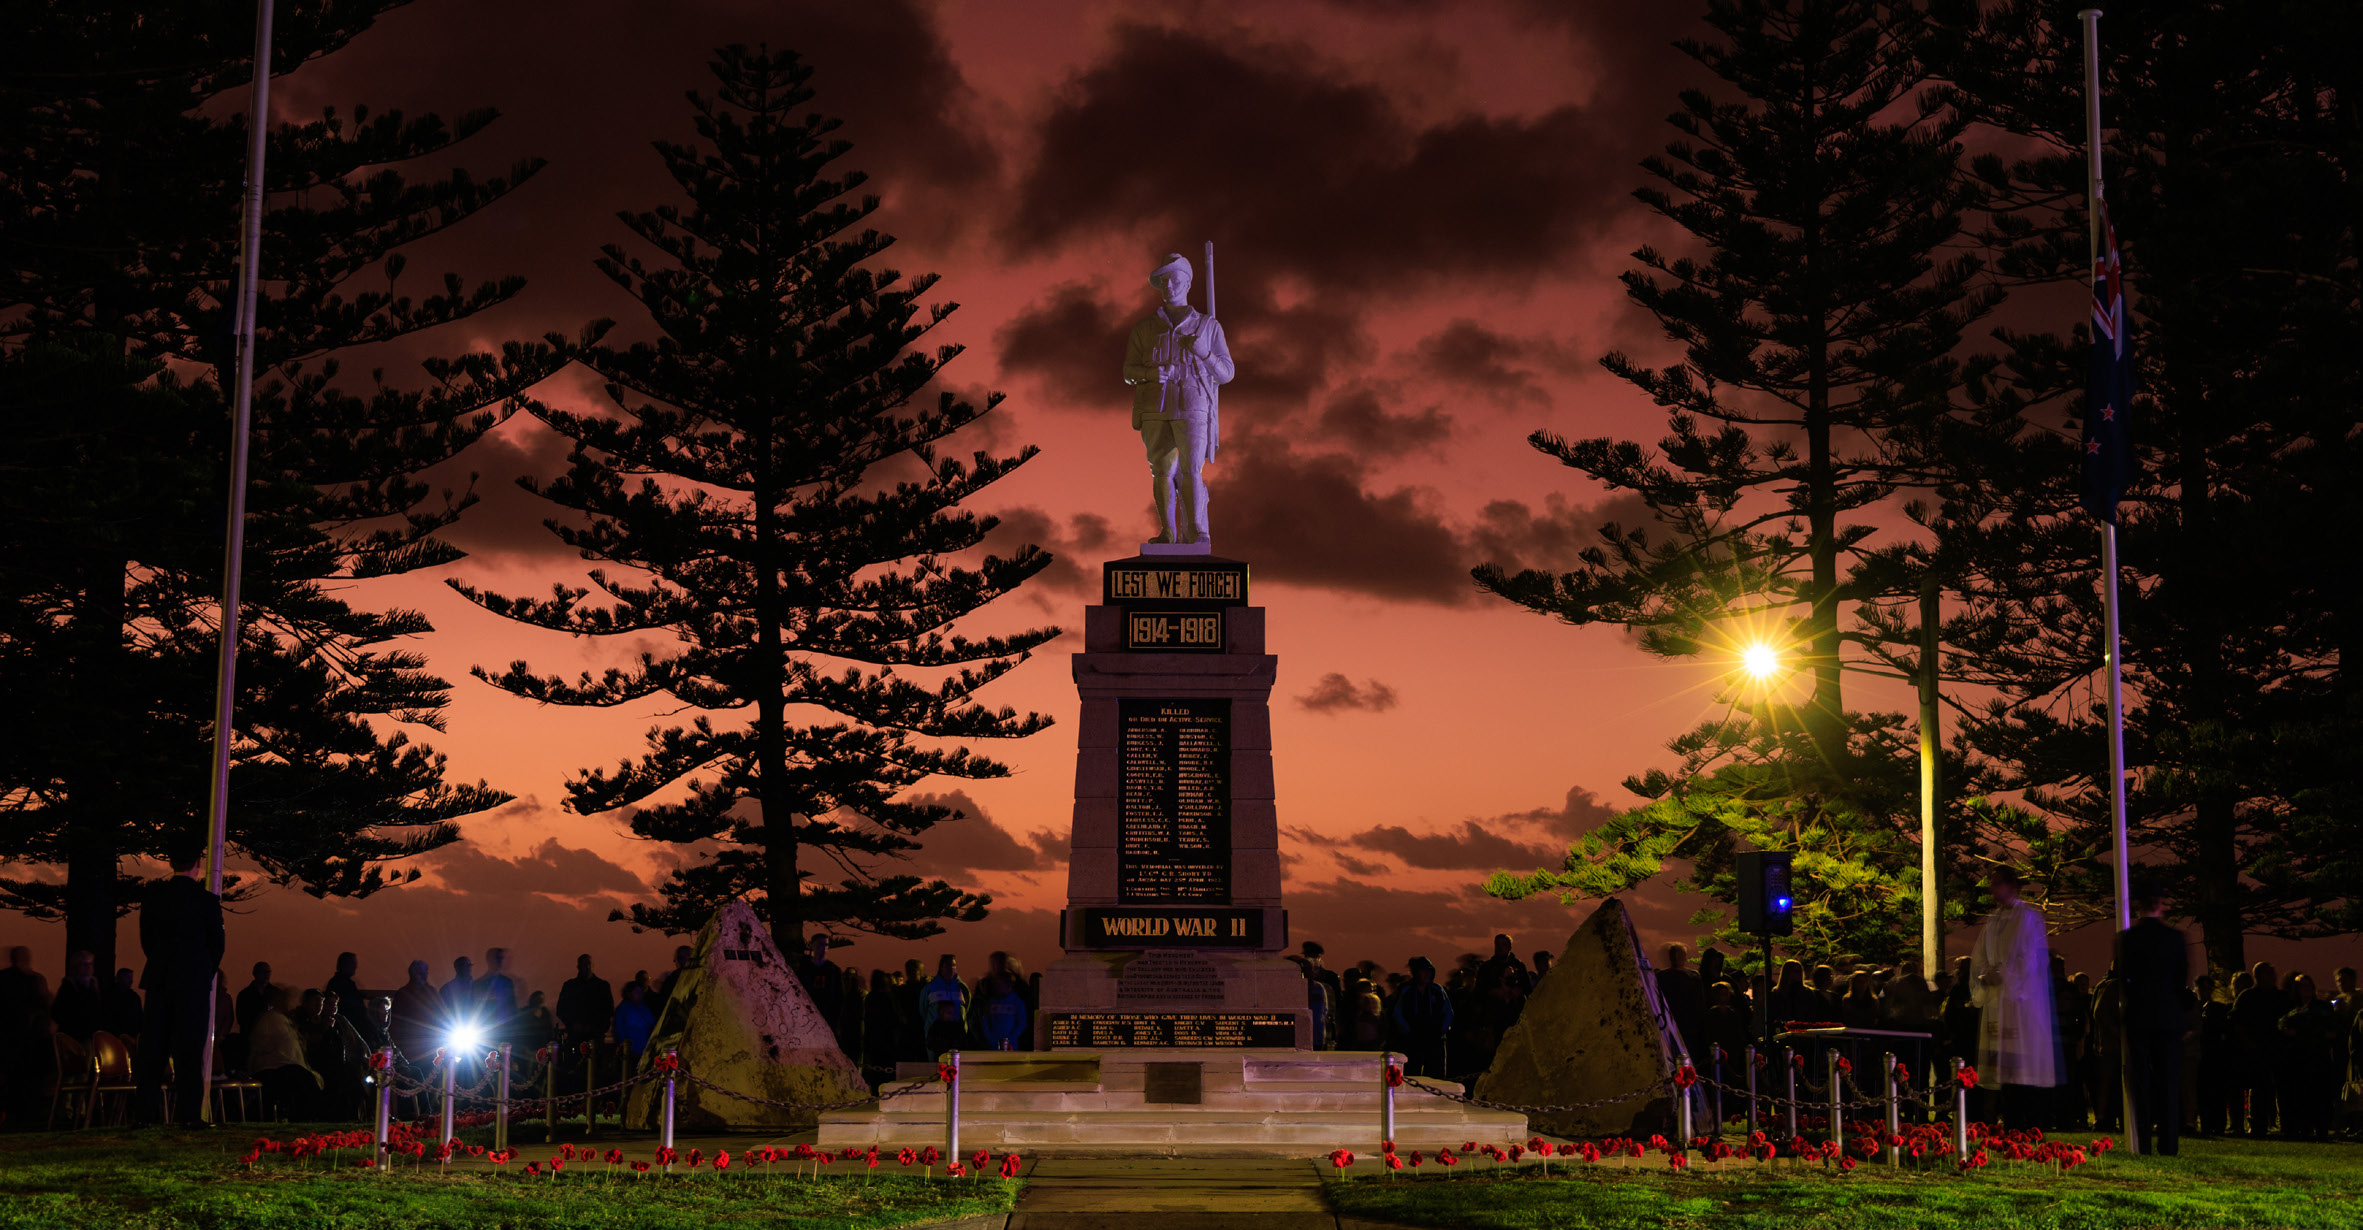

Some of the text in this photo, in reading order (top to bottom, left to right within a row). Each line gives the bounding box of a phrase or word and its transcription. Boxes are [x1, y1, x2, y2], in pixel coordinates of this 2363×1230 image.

[1114, 572, 1239, 598] LEST WE FORGET
[1134, 617, 1216, 643] 1914-1918
[1101, 917, 1246, 937] WORLD WAR II
